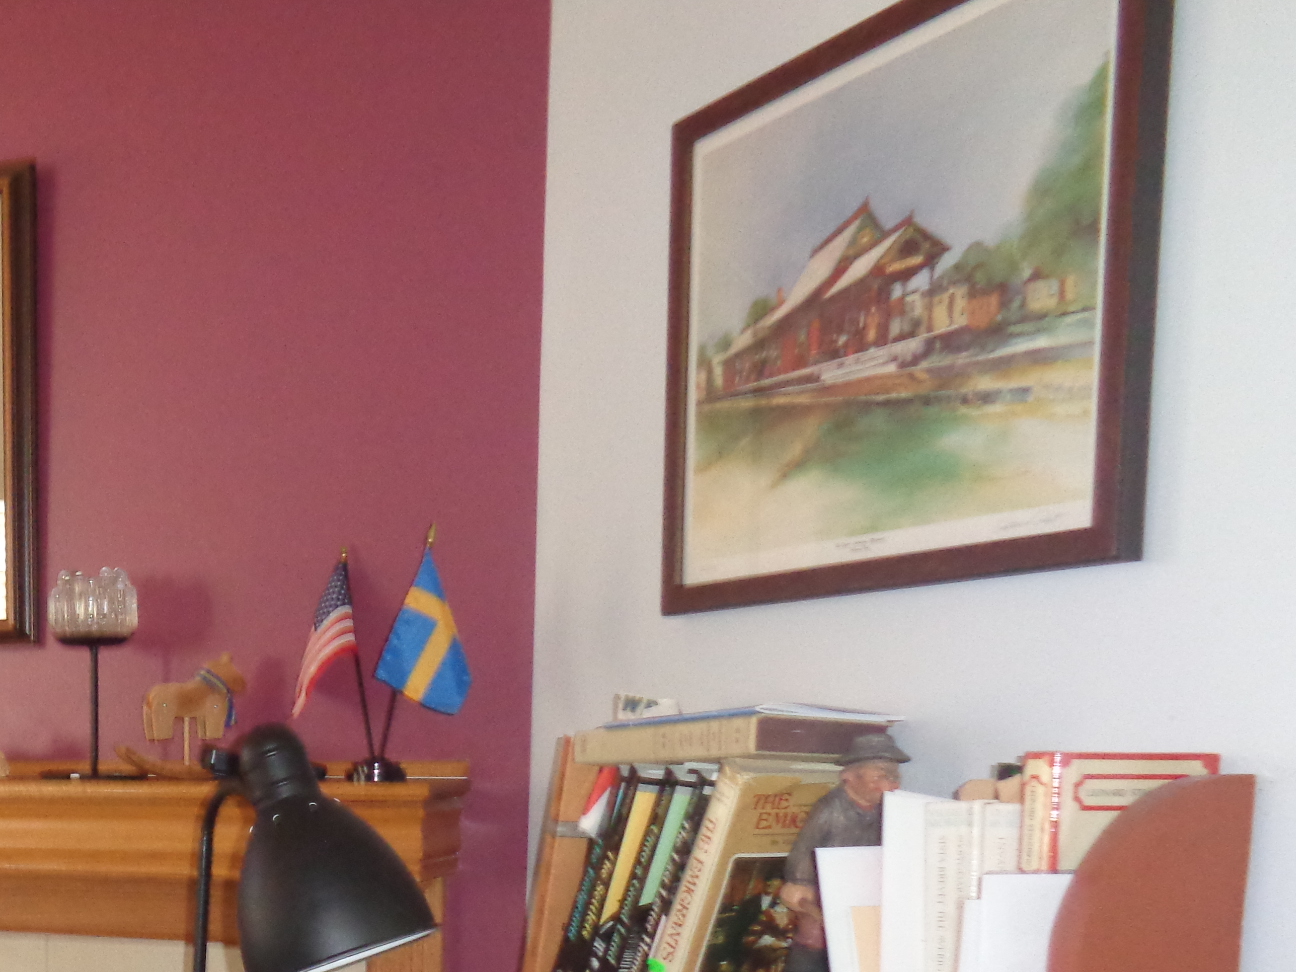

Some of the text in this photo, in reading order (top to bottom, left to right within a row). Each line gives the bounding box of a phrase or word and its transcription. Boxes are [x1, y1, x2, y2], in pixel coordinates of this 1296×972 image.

[752, 792, 793, 810] THE
[755, 810, 809, 830] EMIG
[581, 850, 615, 940] The Settlers
[662, 816, 717, 963] THE EMIGRANTS
